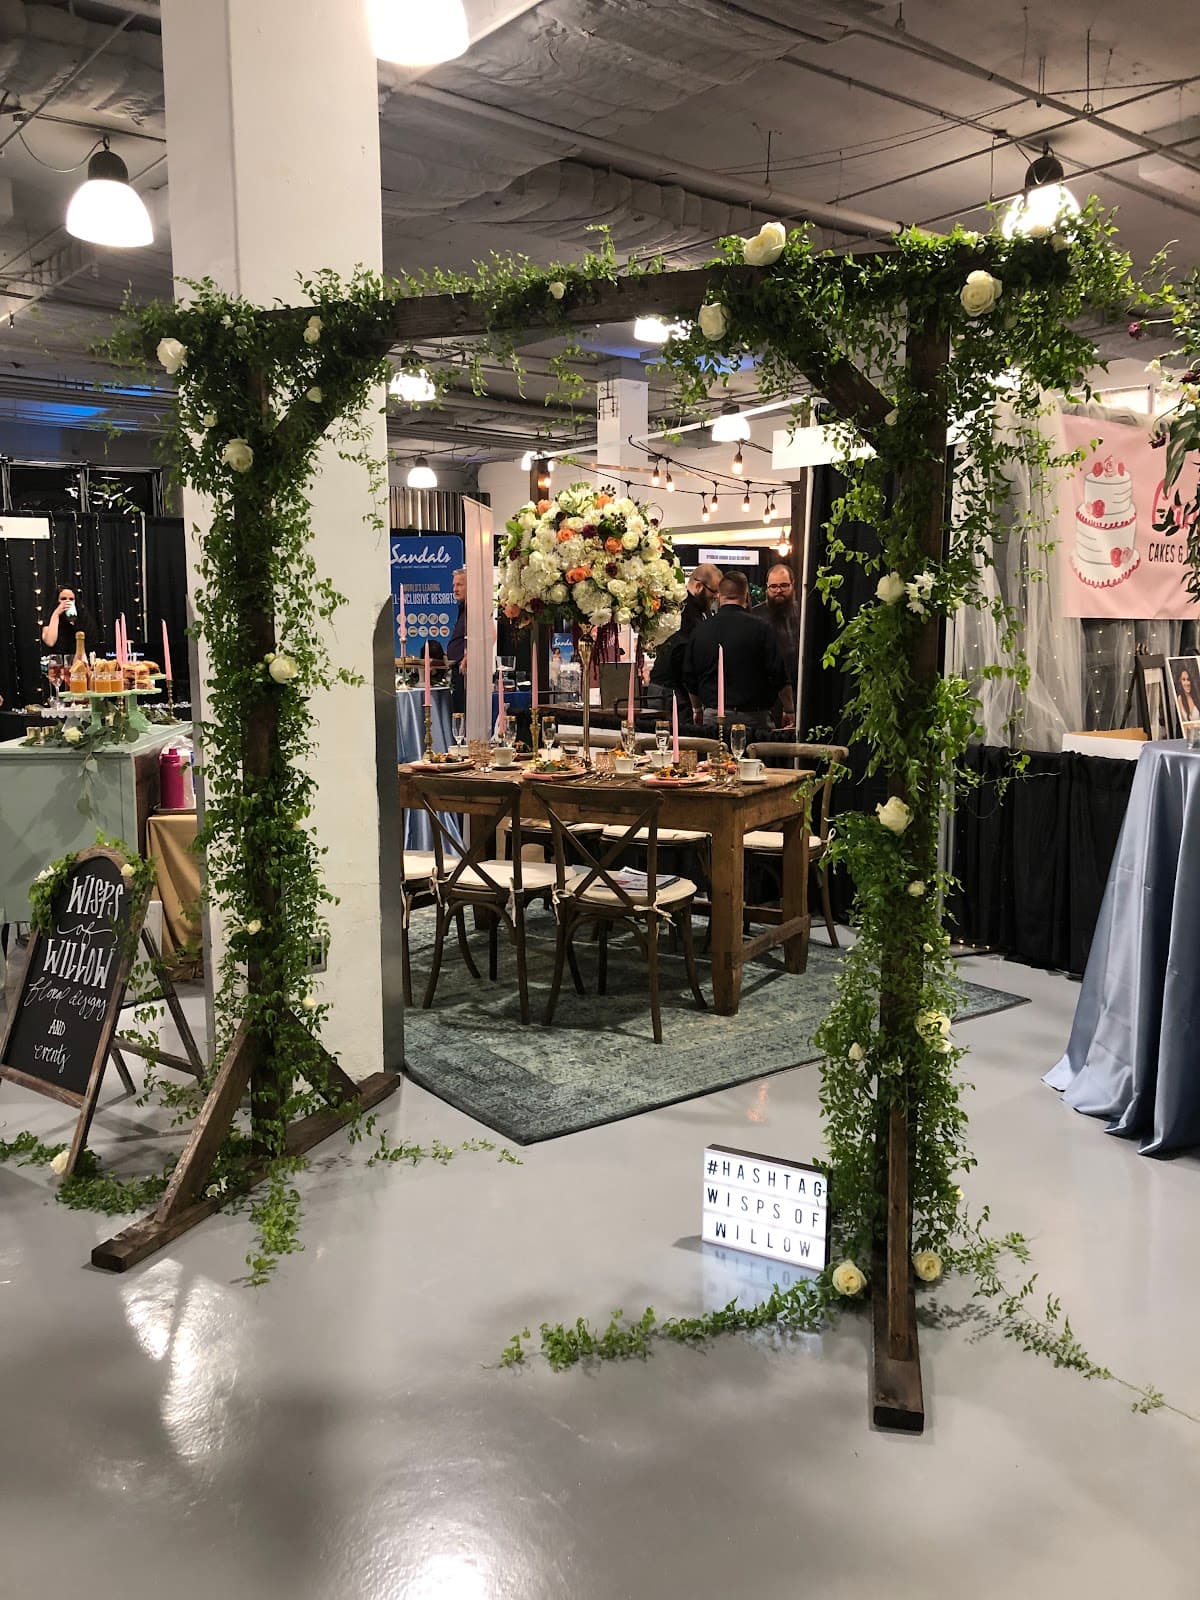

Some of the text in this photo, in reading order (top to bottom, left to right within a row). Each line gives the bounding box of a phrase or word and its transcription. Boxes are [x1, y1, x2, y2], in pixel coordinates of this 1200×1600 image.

[391, 544, 452, 564] Sandals
[1148, 543, 1176, 563] CAKES
[1178, 545, 1184, 563] &
[66, 875, 124, 922] WISPS
[43, 939, 116, 989] WILLOW
[47, 1019, 66, 1036] AND
[34, 1044, 71, 1074] events
[707, 1160, 822, 1197] #HASHTAG
[707, 1187, 820, 1228] WISPS OF
[715, 1221, 811, 1257] WILLOW
